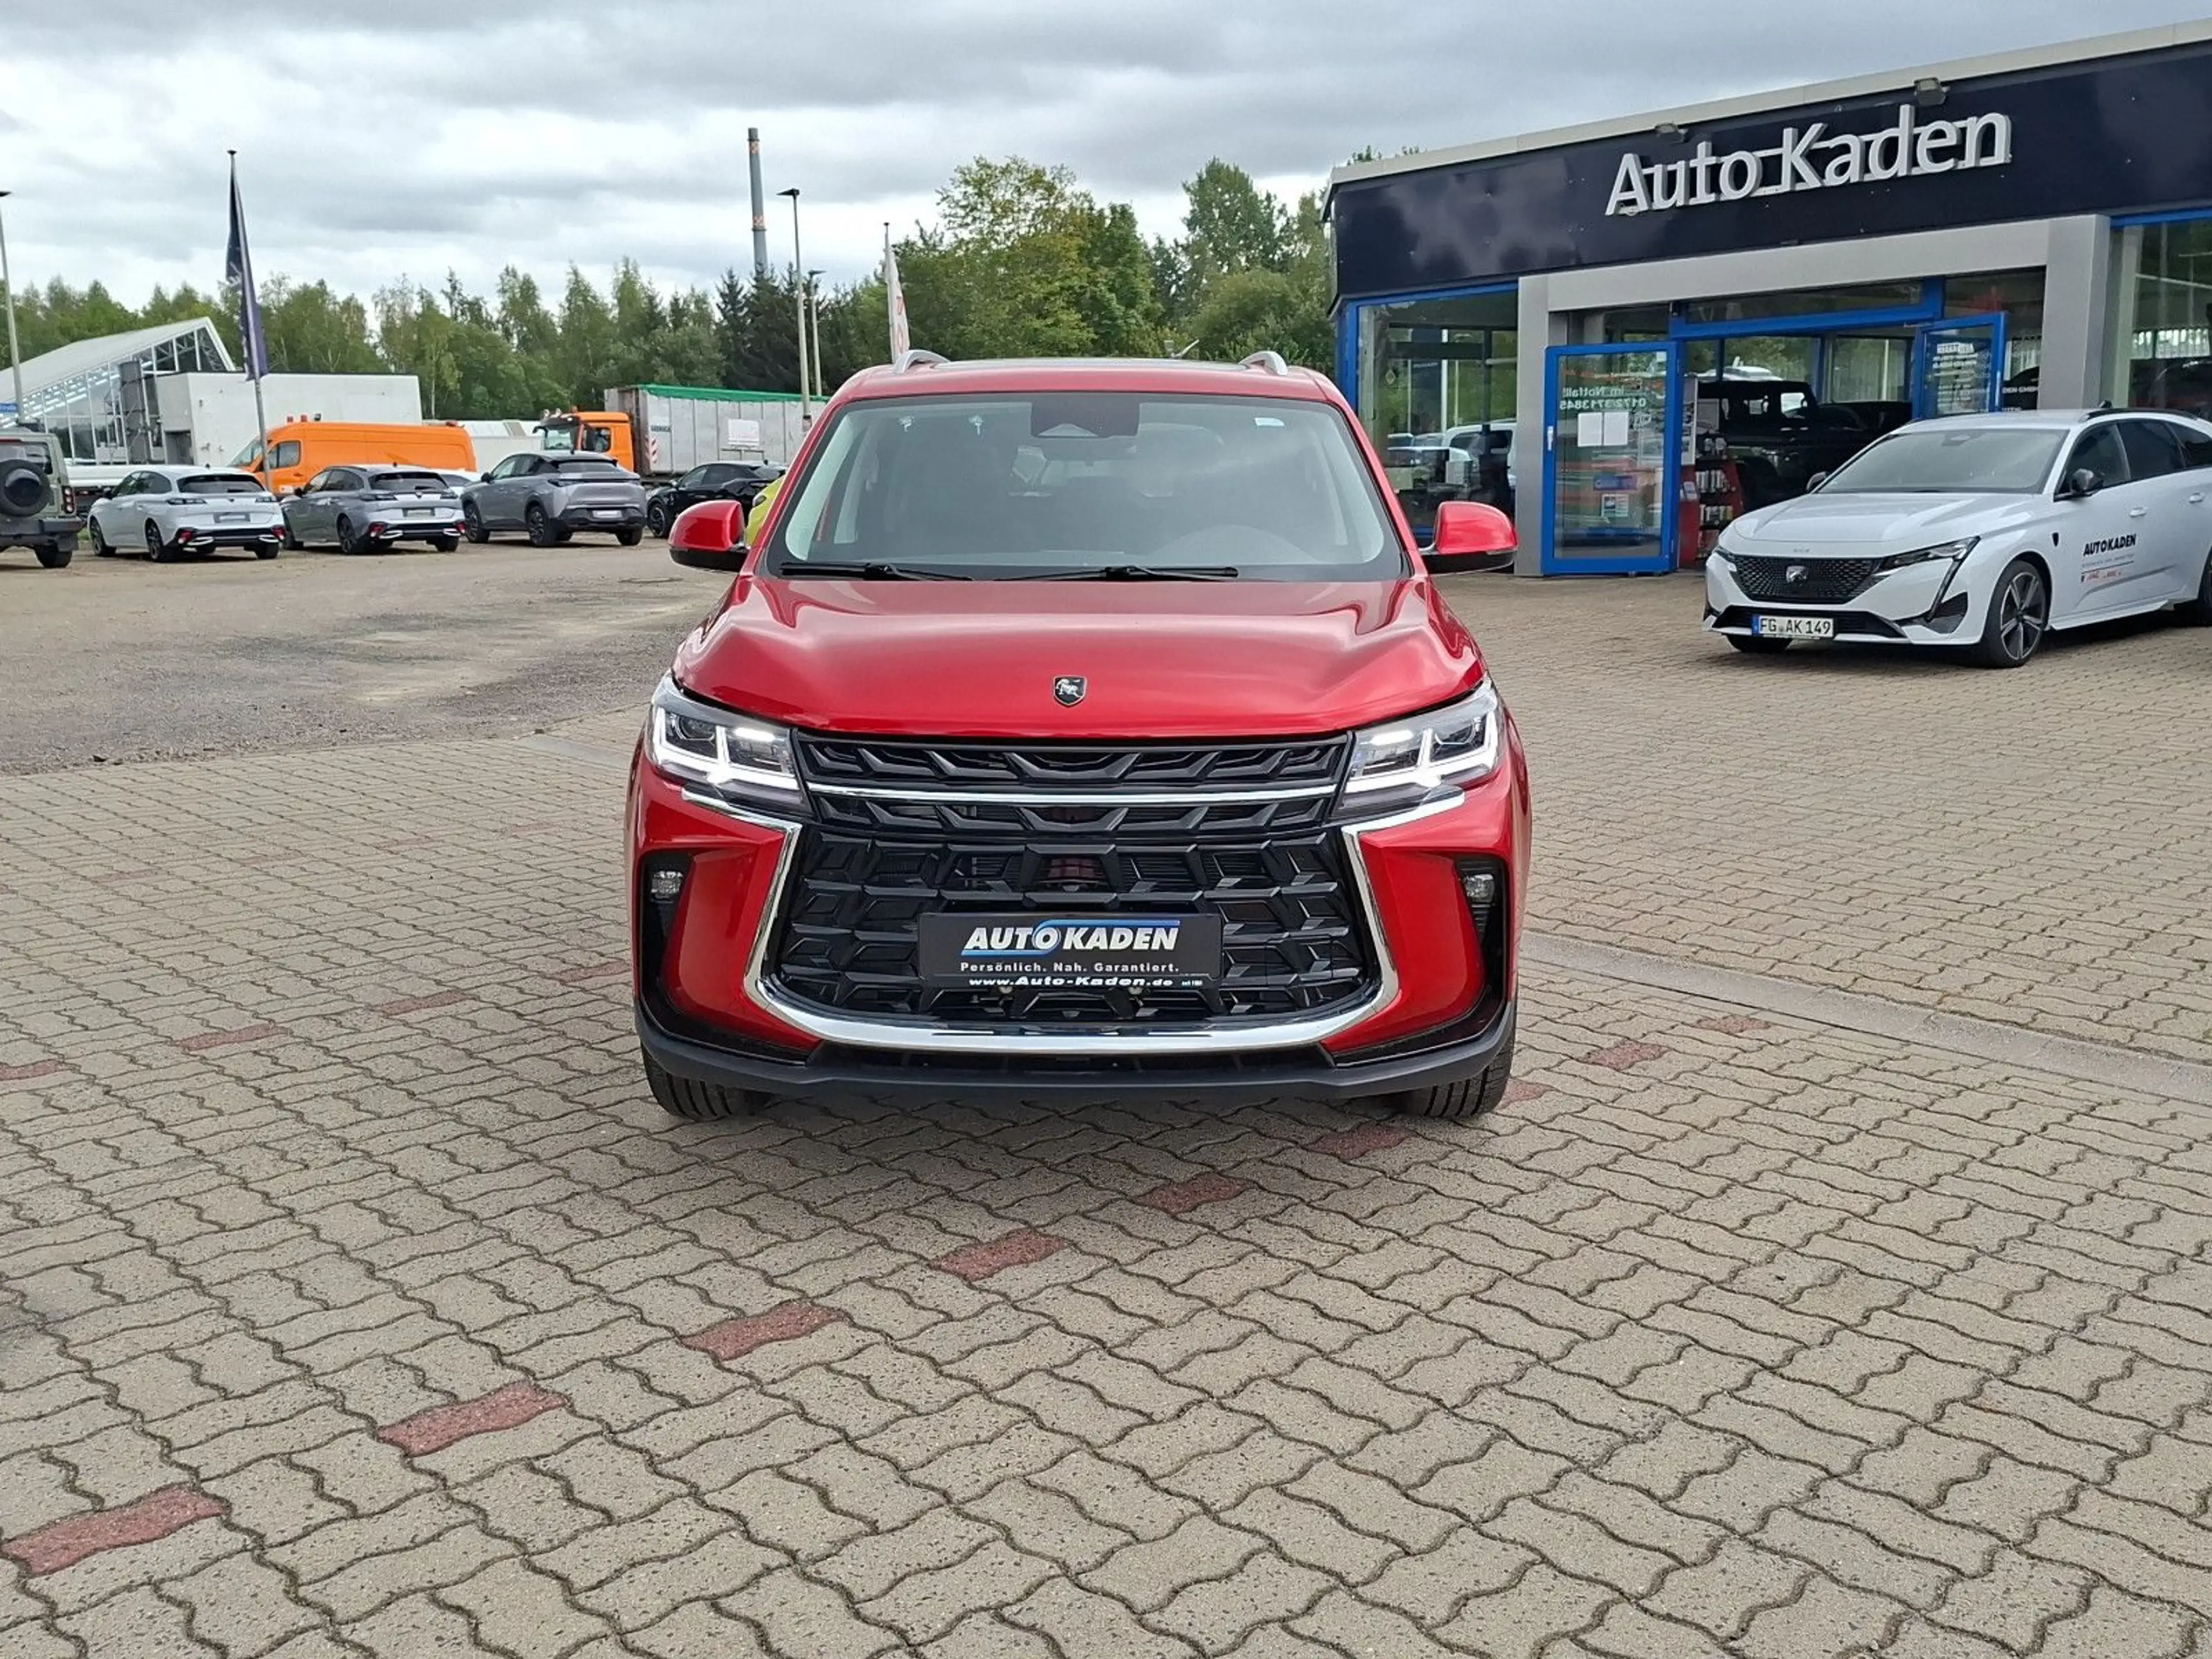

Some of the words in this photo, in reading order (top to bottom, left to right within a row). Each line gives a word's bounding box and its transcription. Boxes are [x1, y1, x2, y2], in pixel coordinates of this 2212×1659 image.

[1605, 142, 1762, 215] Auto
[1781, 104, 2012, 192] Kaden
[1760, 618, 1777, 632] FG
[1786, 619, 1802, 634] AK
[1805, 620, 1831, 634] 149
[960, 961, 1047, 972] Persönlich.
[1053, 961, 1088, 972] Nah.
[1094, 962, 1179, 972] Garantiert.
[969, 976, 1173, 986] www.Auto-Kaden.de
